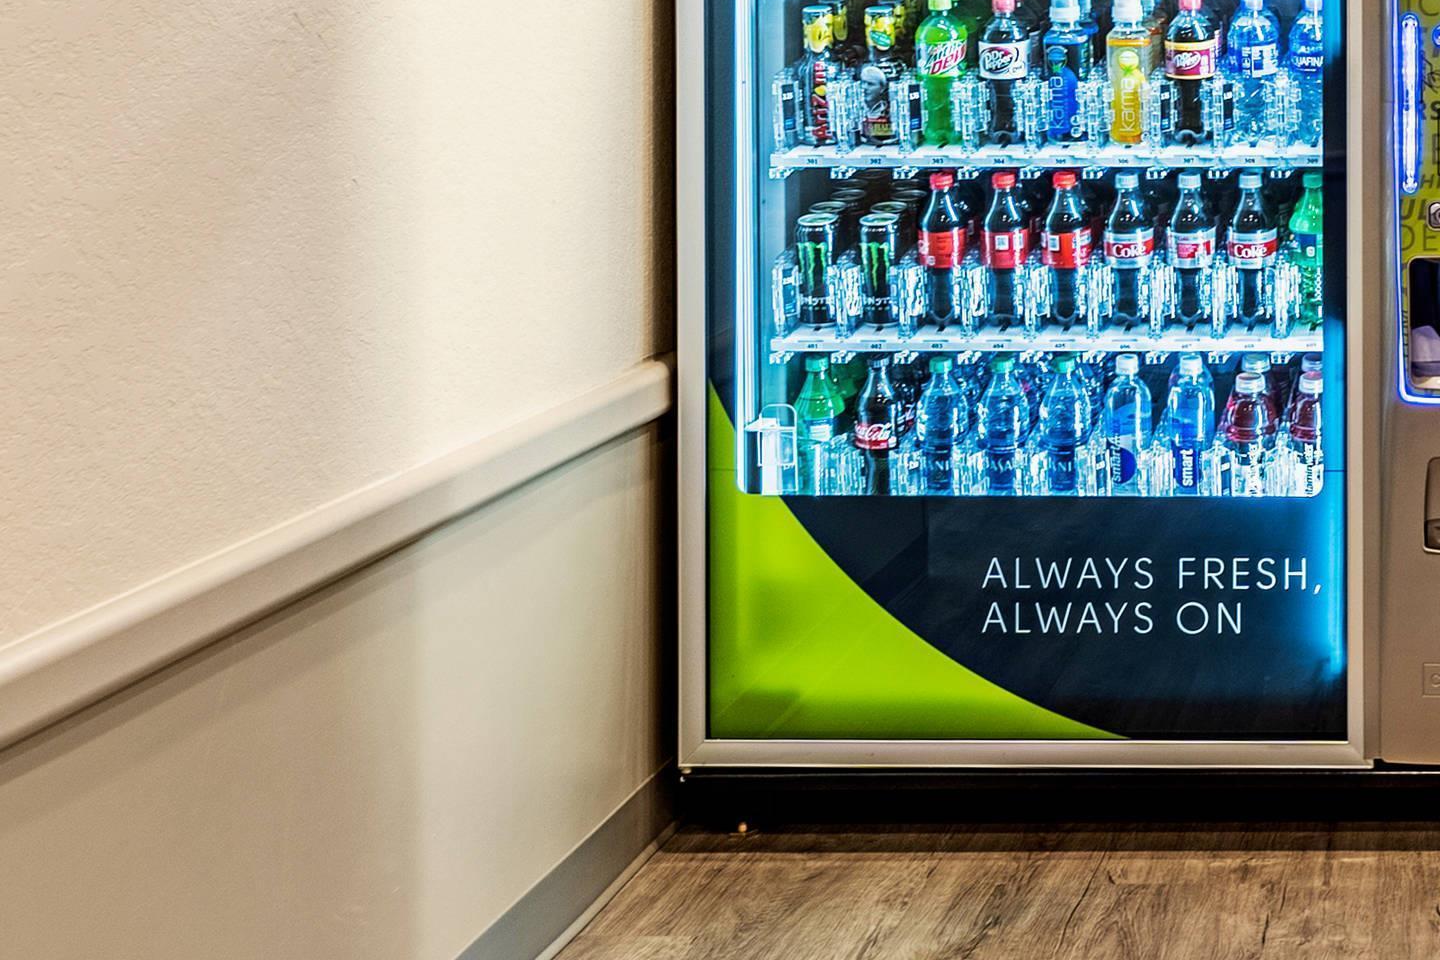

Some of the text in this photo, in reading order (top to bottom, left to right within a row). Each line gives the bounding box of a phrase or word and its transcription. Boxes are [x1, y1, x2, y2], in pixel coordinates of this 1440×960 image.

[1112, 243, 1147, 258] Coke
[1233, 244, 1268, 259] Coke
[1180, 448, 1194, 487] smart
[981, 557, 1322, 595] ALWAYS FRESH,
[981, 602, 1242, 634] ALWAYS ON
